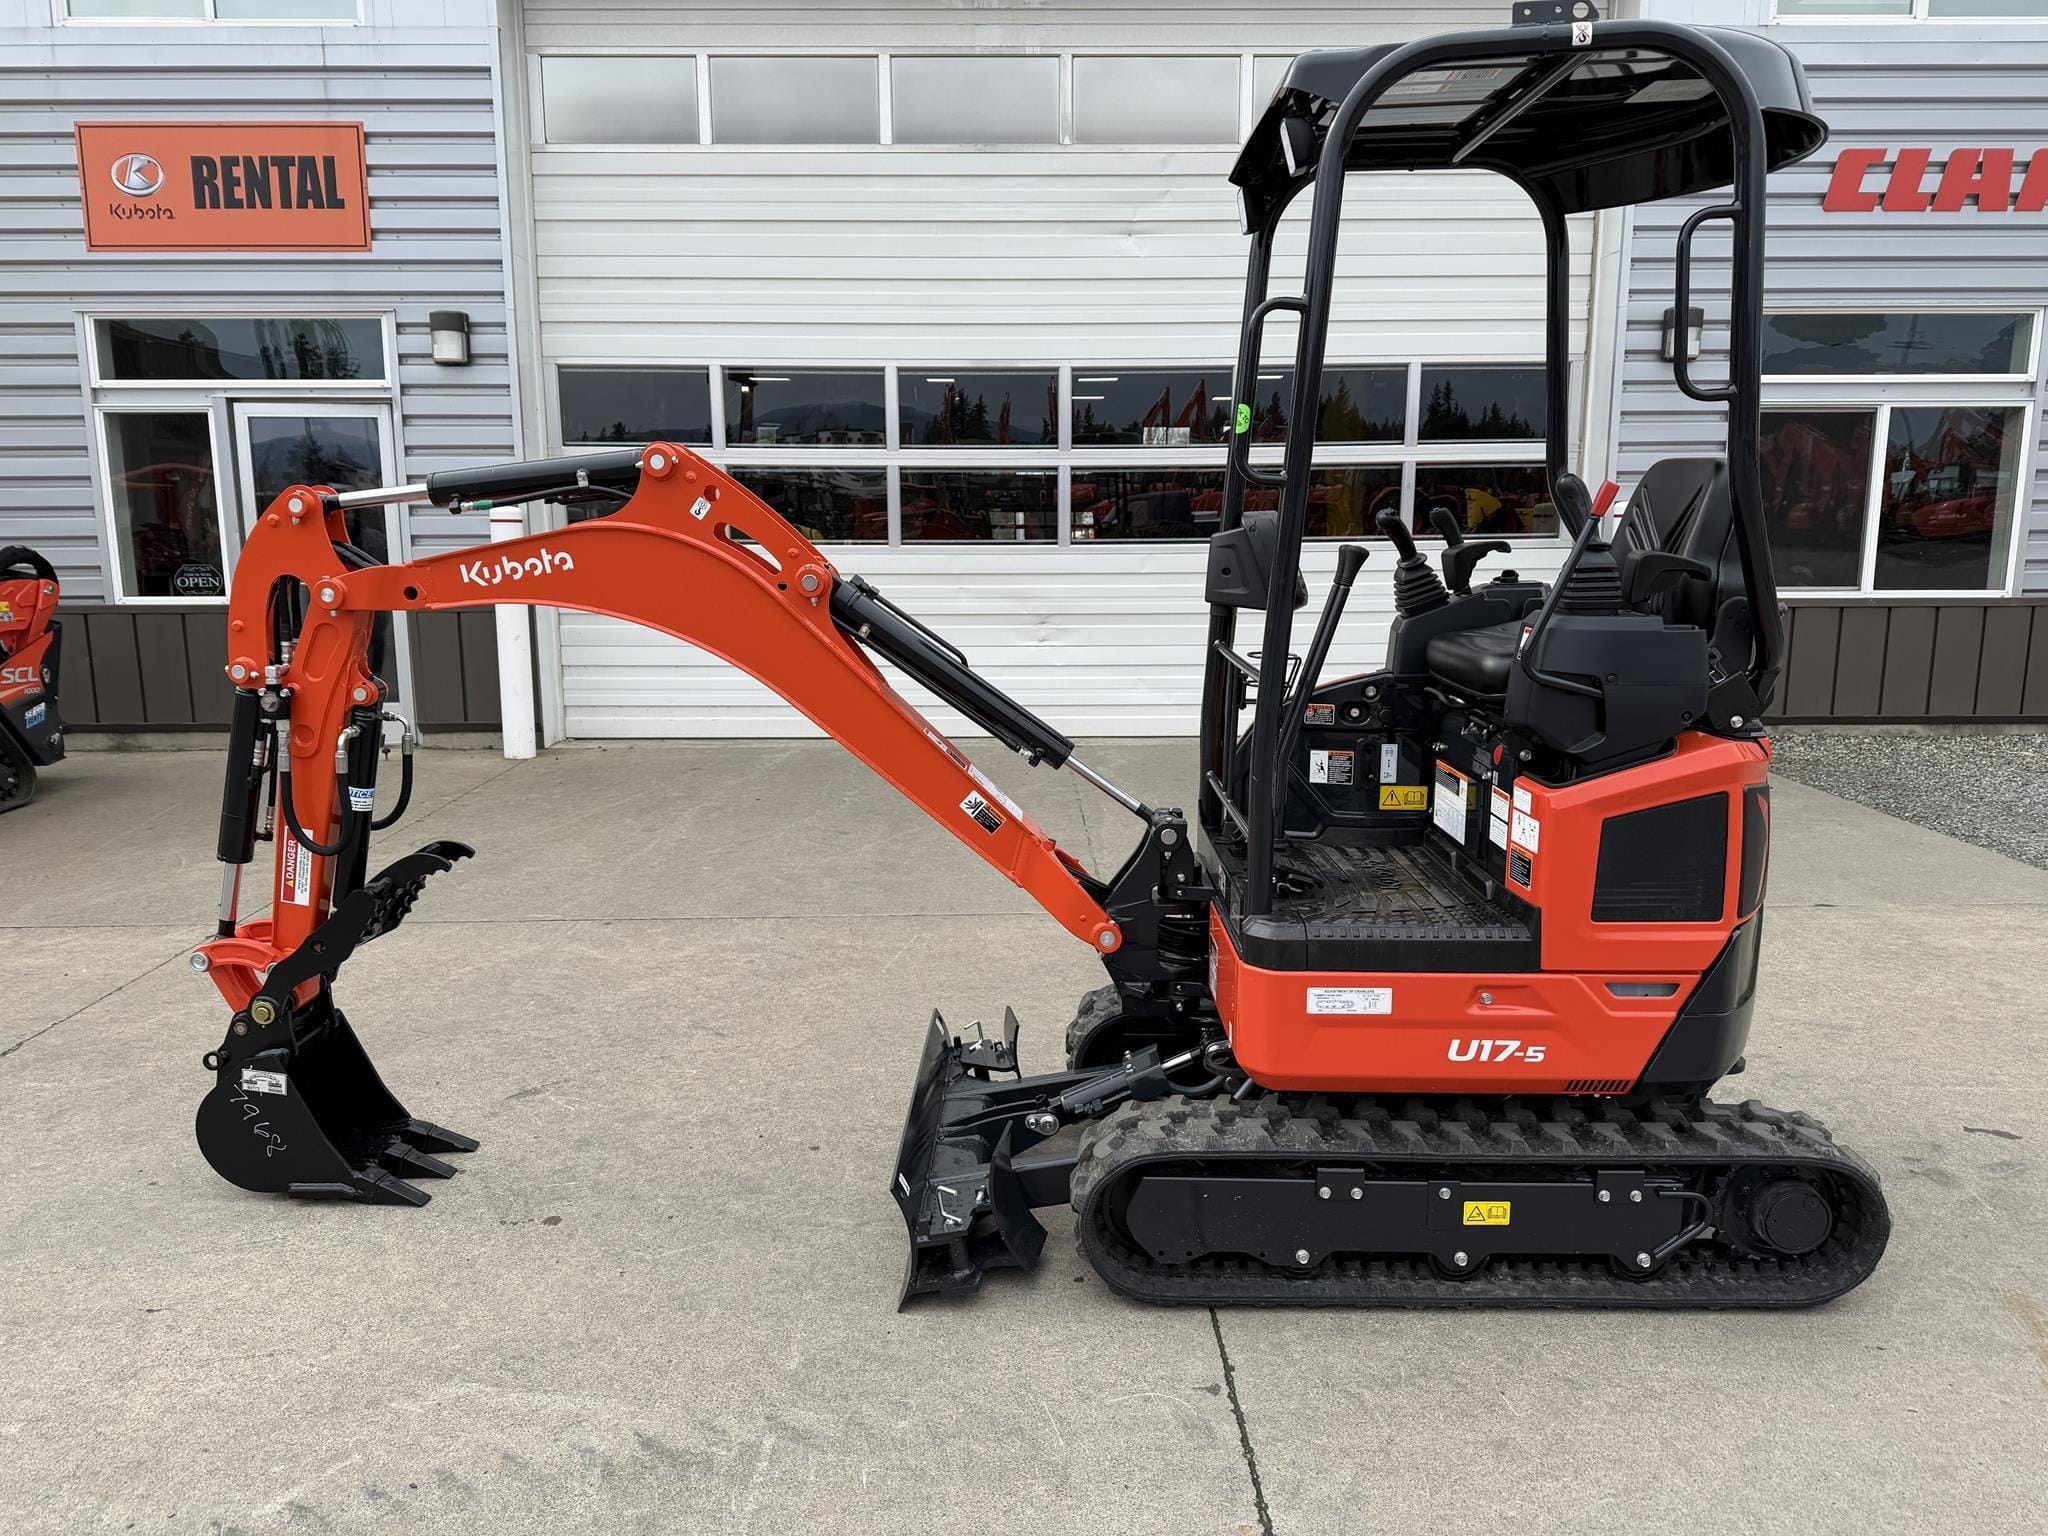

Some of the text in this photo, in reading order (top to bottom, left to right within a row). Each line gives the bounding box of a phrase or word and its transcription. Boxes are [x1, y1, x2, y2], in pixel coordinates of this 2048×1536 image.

[190, 155, 345, 209] RENTAL
[109, 203, 174, 220] Kubota
[460, 548, 574, 586] Kubota
[177, 577, 219, 587] OPEN
[1, 667, 38, 684] SCL
[286, 840, 297, 879] DANGER
[1447, 1039, 1546, 1062] U17-5
